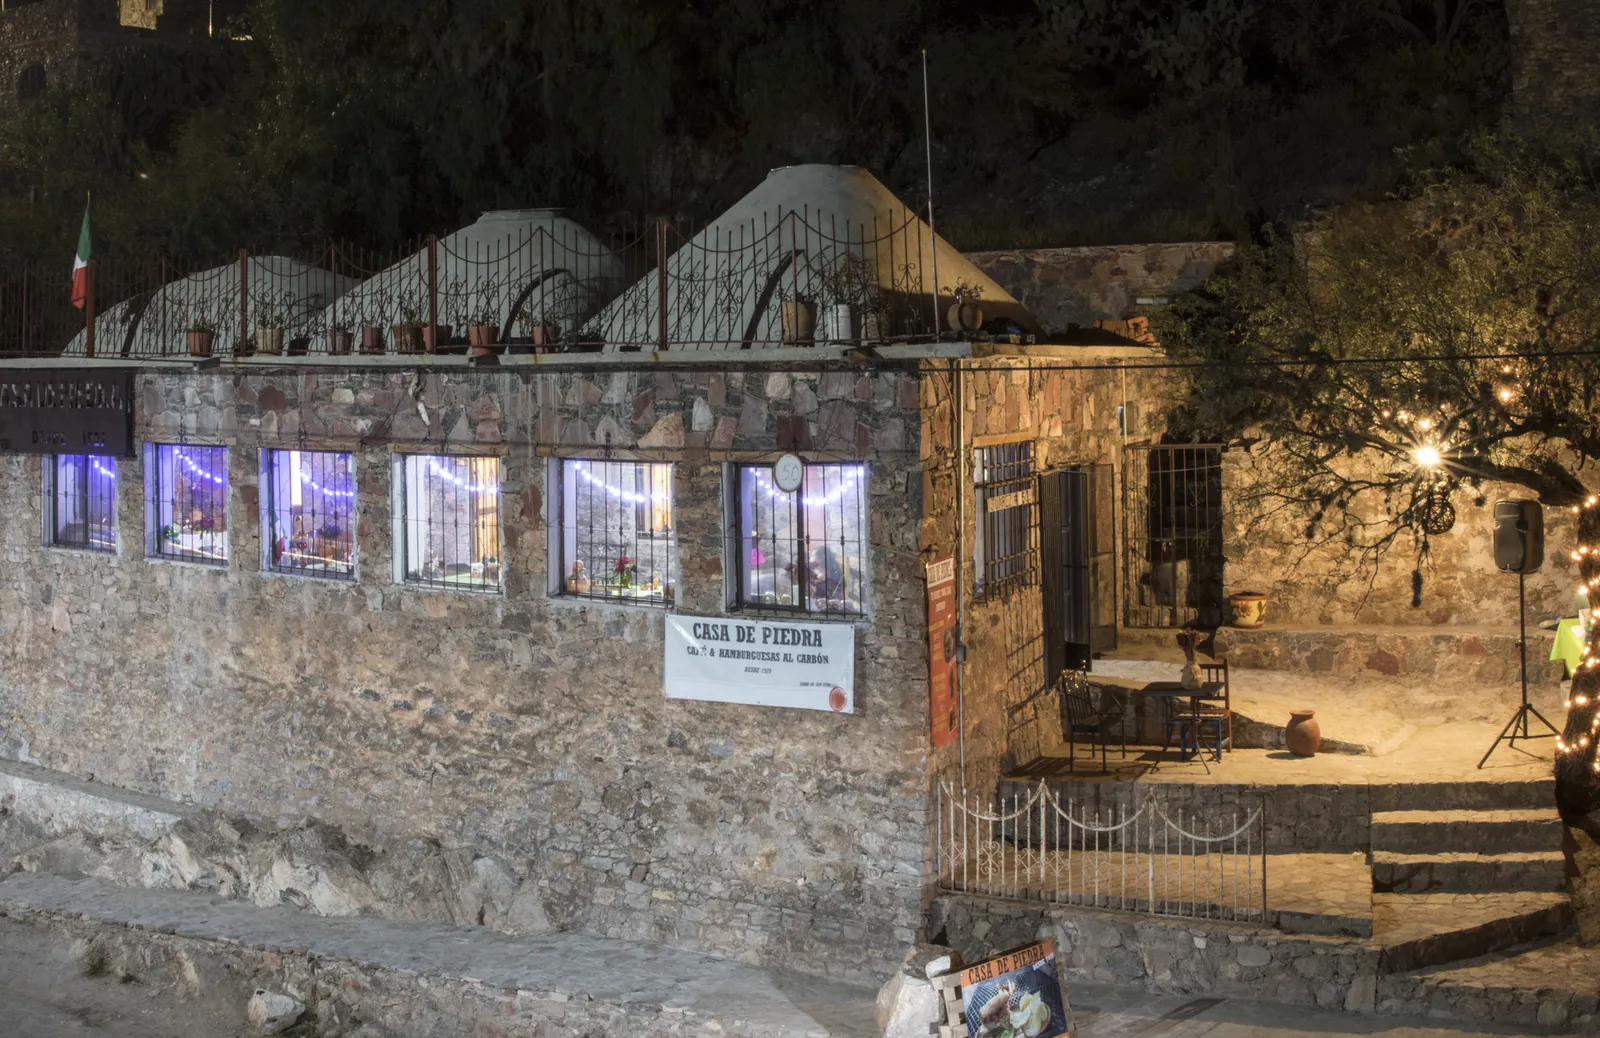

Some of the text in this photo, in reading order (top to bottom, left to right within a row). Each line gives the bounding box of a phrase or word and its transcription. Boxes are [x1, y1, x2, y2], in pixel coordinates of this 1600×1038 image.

[693, 622, 823, 648] CASA DE PIEDRA
[709, 649, 715, 658] &
[718, 648, 781, 662] HAMBURGUESAS
[783, 653, 794, 663] AL
[796, 652, 829, 665] CARBÓN
[743, 666, 760, 674] DESDE
[968, 945, 1046, 985] CASA DE PIEDRA
